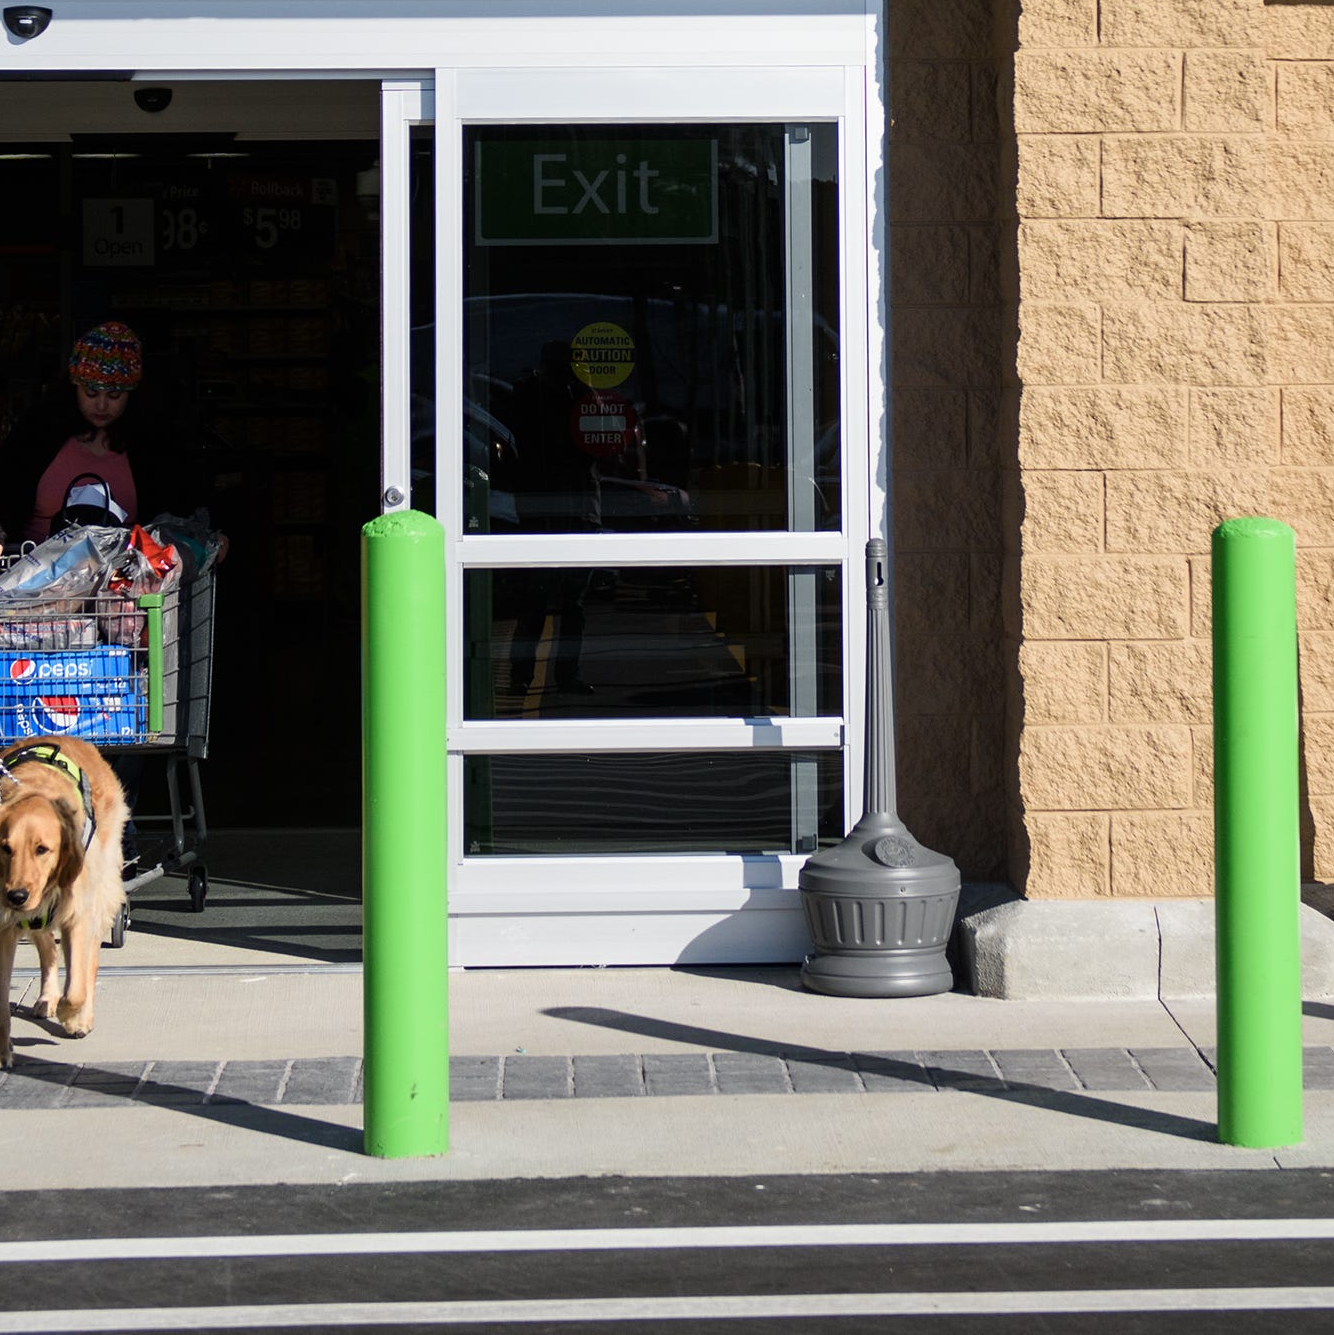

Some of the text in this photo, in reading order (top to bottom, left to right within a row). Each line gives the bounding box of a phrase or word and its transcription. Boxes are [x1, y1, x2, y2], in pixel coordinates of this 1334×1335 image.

[251, 180, 304, 197] Rollback
[534, 153, 659, 214] Exit
[110, 206, 123, 233] 1
[95, 238, 143, 258] Open
[576, 337, 629, 345] AUTOMATIC
[572, 349, 632, 362] CAUTION
[590, 366, 616, 374] DOOR
[581, 404, 625, 414] DO NOT
[584, 433, 621, 443] ENTER
[38, 659, 93, 678] pepsi
